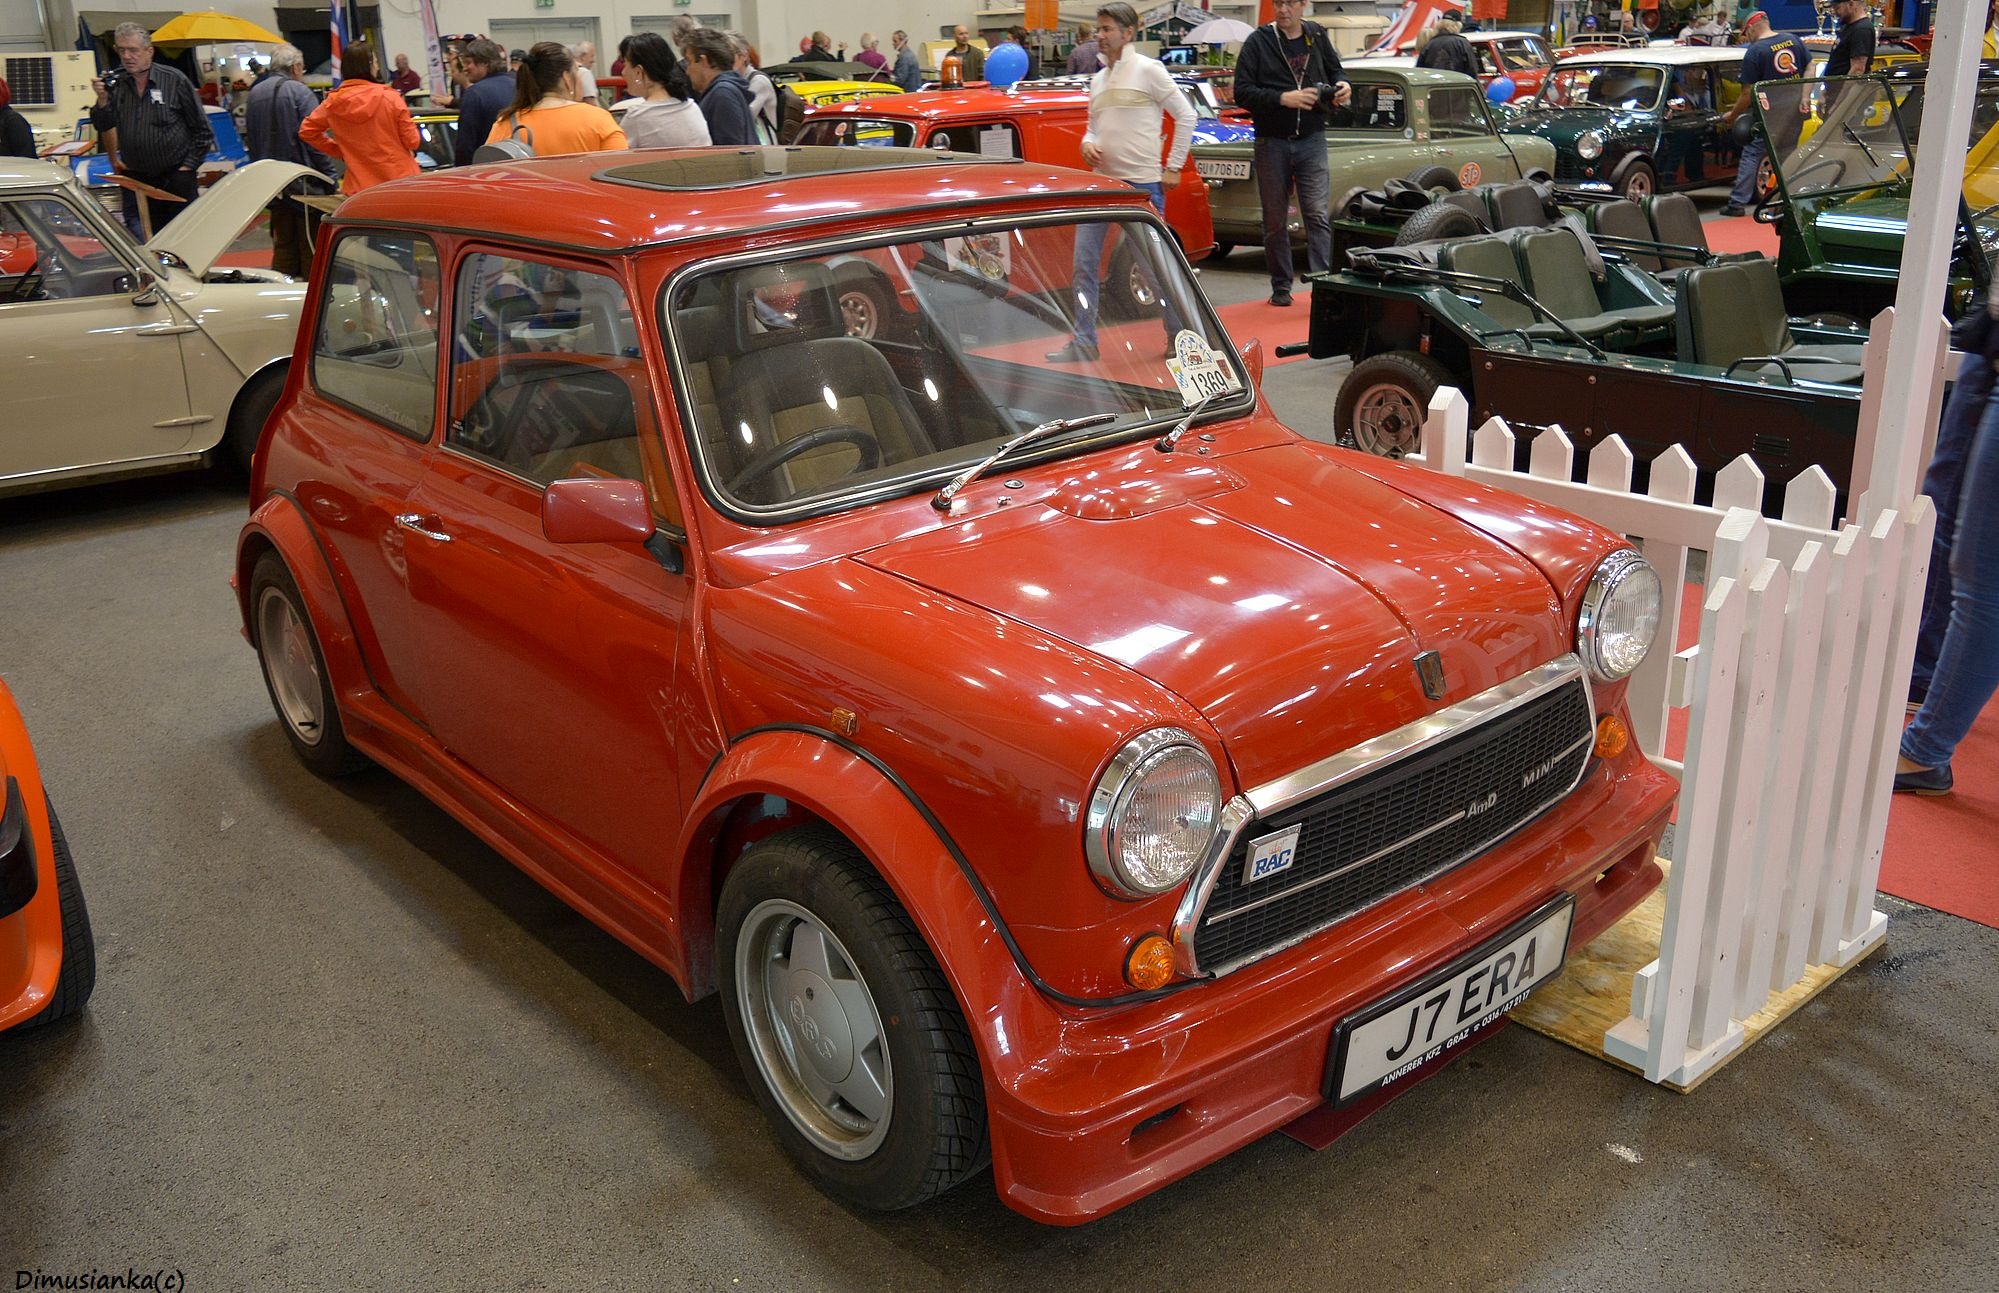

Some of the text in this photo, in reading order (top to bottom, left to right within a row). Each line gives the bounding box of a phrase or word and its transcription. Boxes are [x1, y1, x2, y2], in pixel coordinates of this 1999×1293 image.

[1770, 39, 1794, 52] SERVICE
[1198, 162, 1247, 177] GU 706 CZ
[1462, 165, 1479, 185] STP
[1190, 370, 1229, 398] 1369
[1253, 848, 1292, 878] RAC
[1386, 936, 1537, 1062] J7 ERA
[1381, 1056, 1424, 1087] ANNERER
[1425, 1045, 1442, 1063] KFZ
[1446, 1029, 1470, 1050] GRAZ
